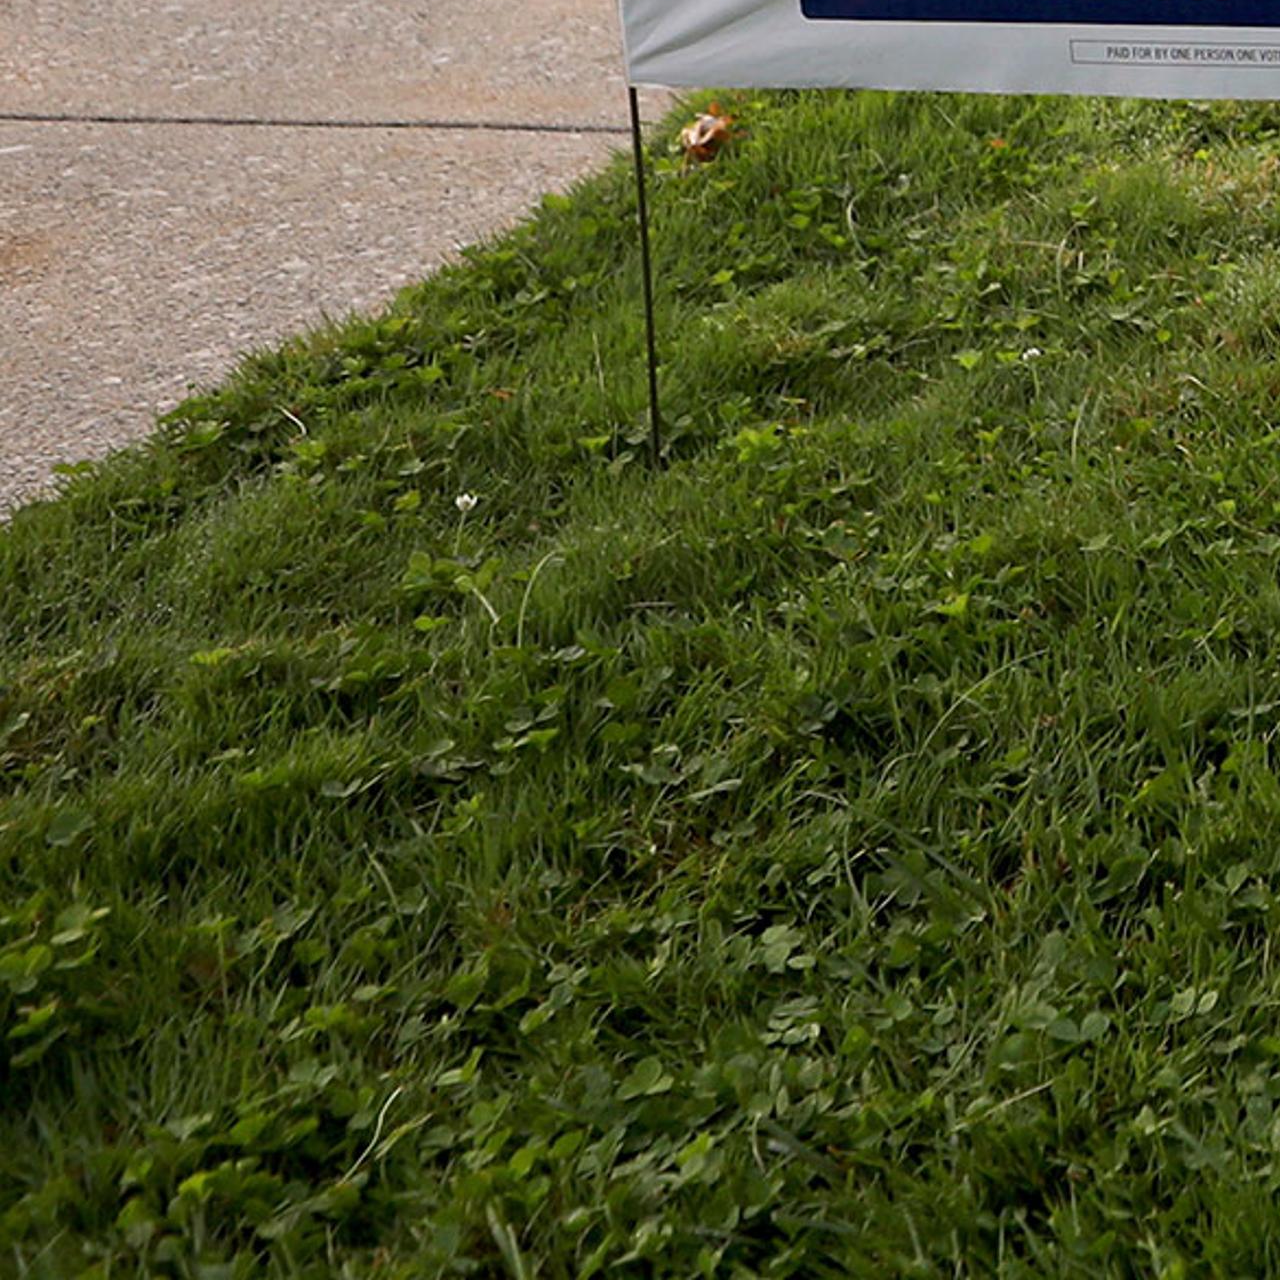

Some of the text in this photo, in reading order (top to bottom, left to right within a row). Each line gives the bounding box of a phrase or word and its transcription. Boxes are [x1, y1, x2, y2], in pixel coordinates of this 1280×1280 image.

[1107, 46, 1130, 59] PAID
[1132, 46, 1151, 59] FOR
[1154, 47, 1169, 59] BY
[1170, 47, 1192, 60] ONE
[1194, 48, 1234, 60] PERSON
[1235, 49, 1257, 61] ONE
